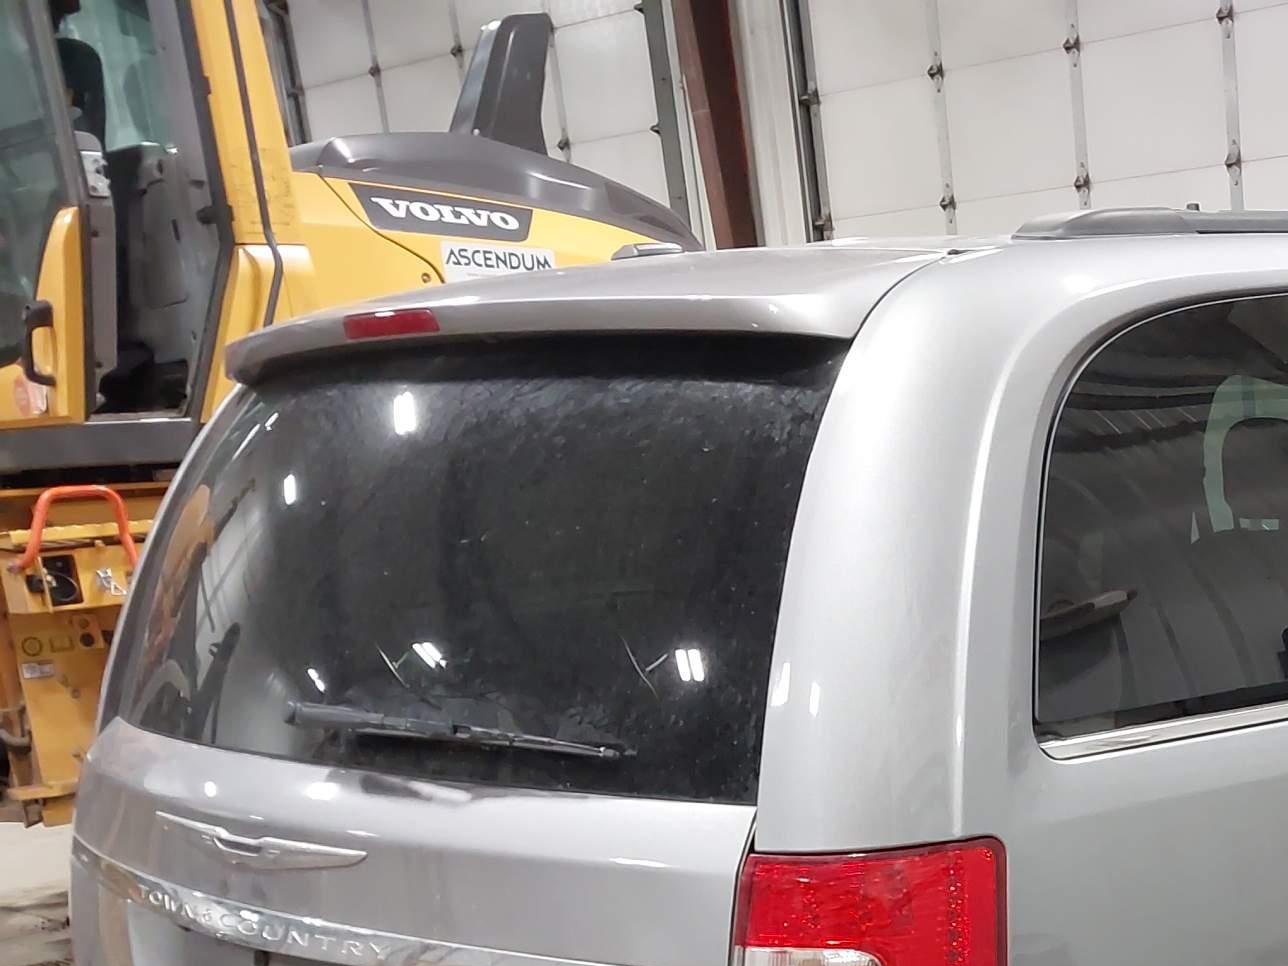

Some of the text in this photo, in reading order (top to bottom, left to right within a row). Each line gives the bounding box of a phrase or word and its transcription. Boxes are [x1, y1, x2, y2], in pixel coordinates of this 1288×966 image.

[370, 197, 520, 230] VOLVO
[445, 248, 552, 271] ASCENDUM
[137, 884, 196, 920] TOWN
[219, 912, 392, 961] COUNTRY
